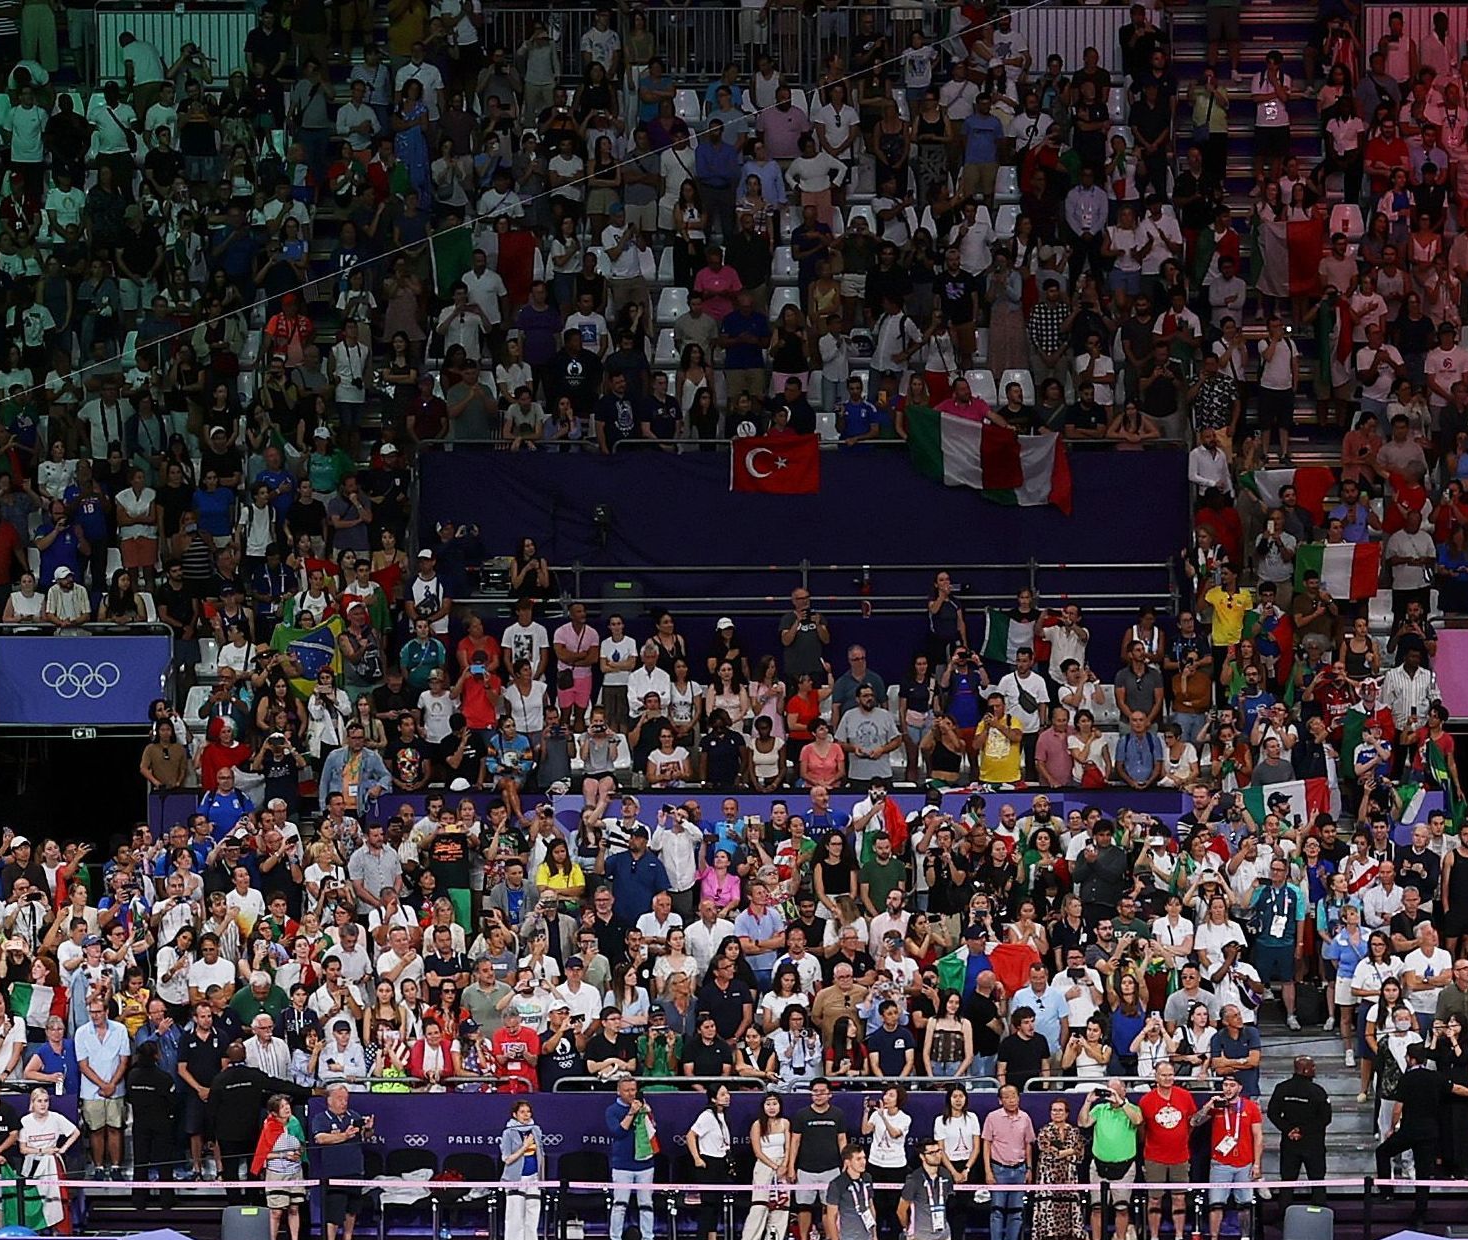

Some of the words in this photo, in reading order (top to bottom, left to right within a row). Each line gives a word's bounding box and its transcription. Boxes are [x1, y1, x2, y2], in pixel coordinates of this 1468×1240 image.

[83, 503, 94, 514] 18
[448, 1135, 484, 1144] PARIS
[486, 1135, 503, 1144] 20
[582, 1135, 614, 1144] PARI
